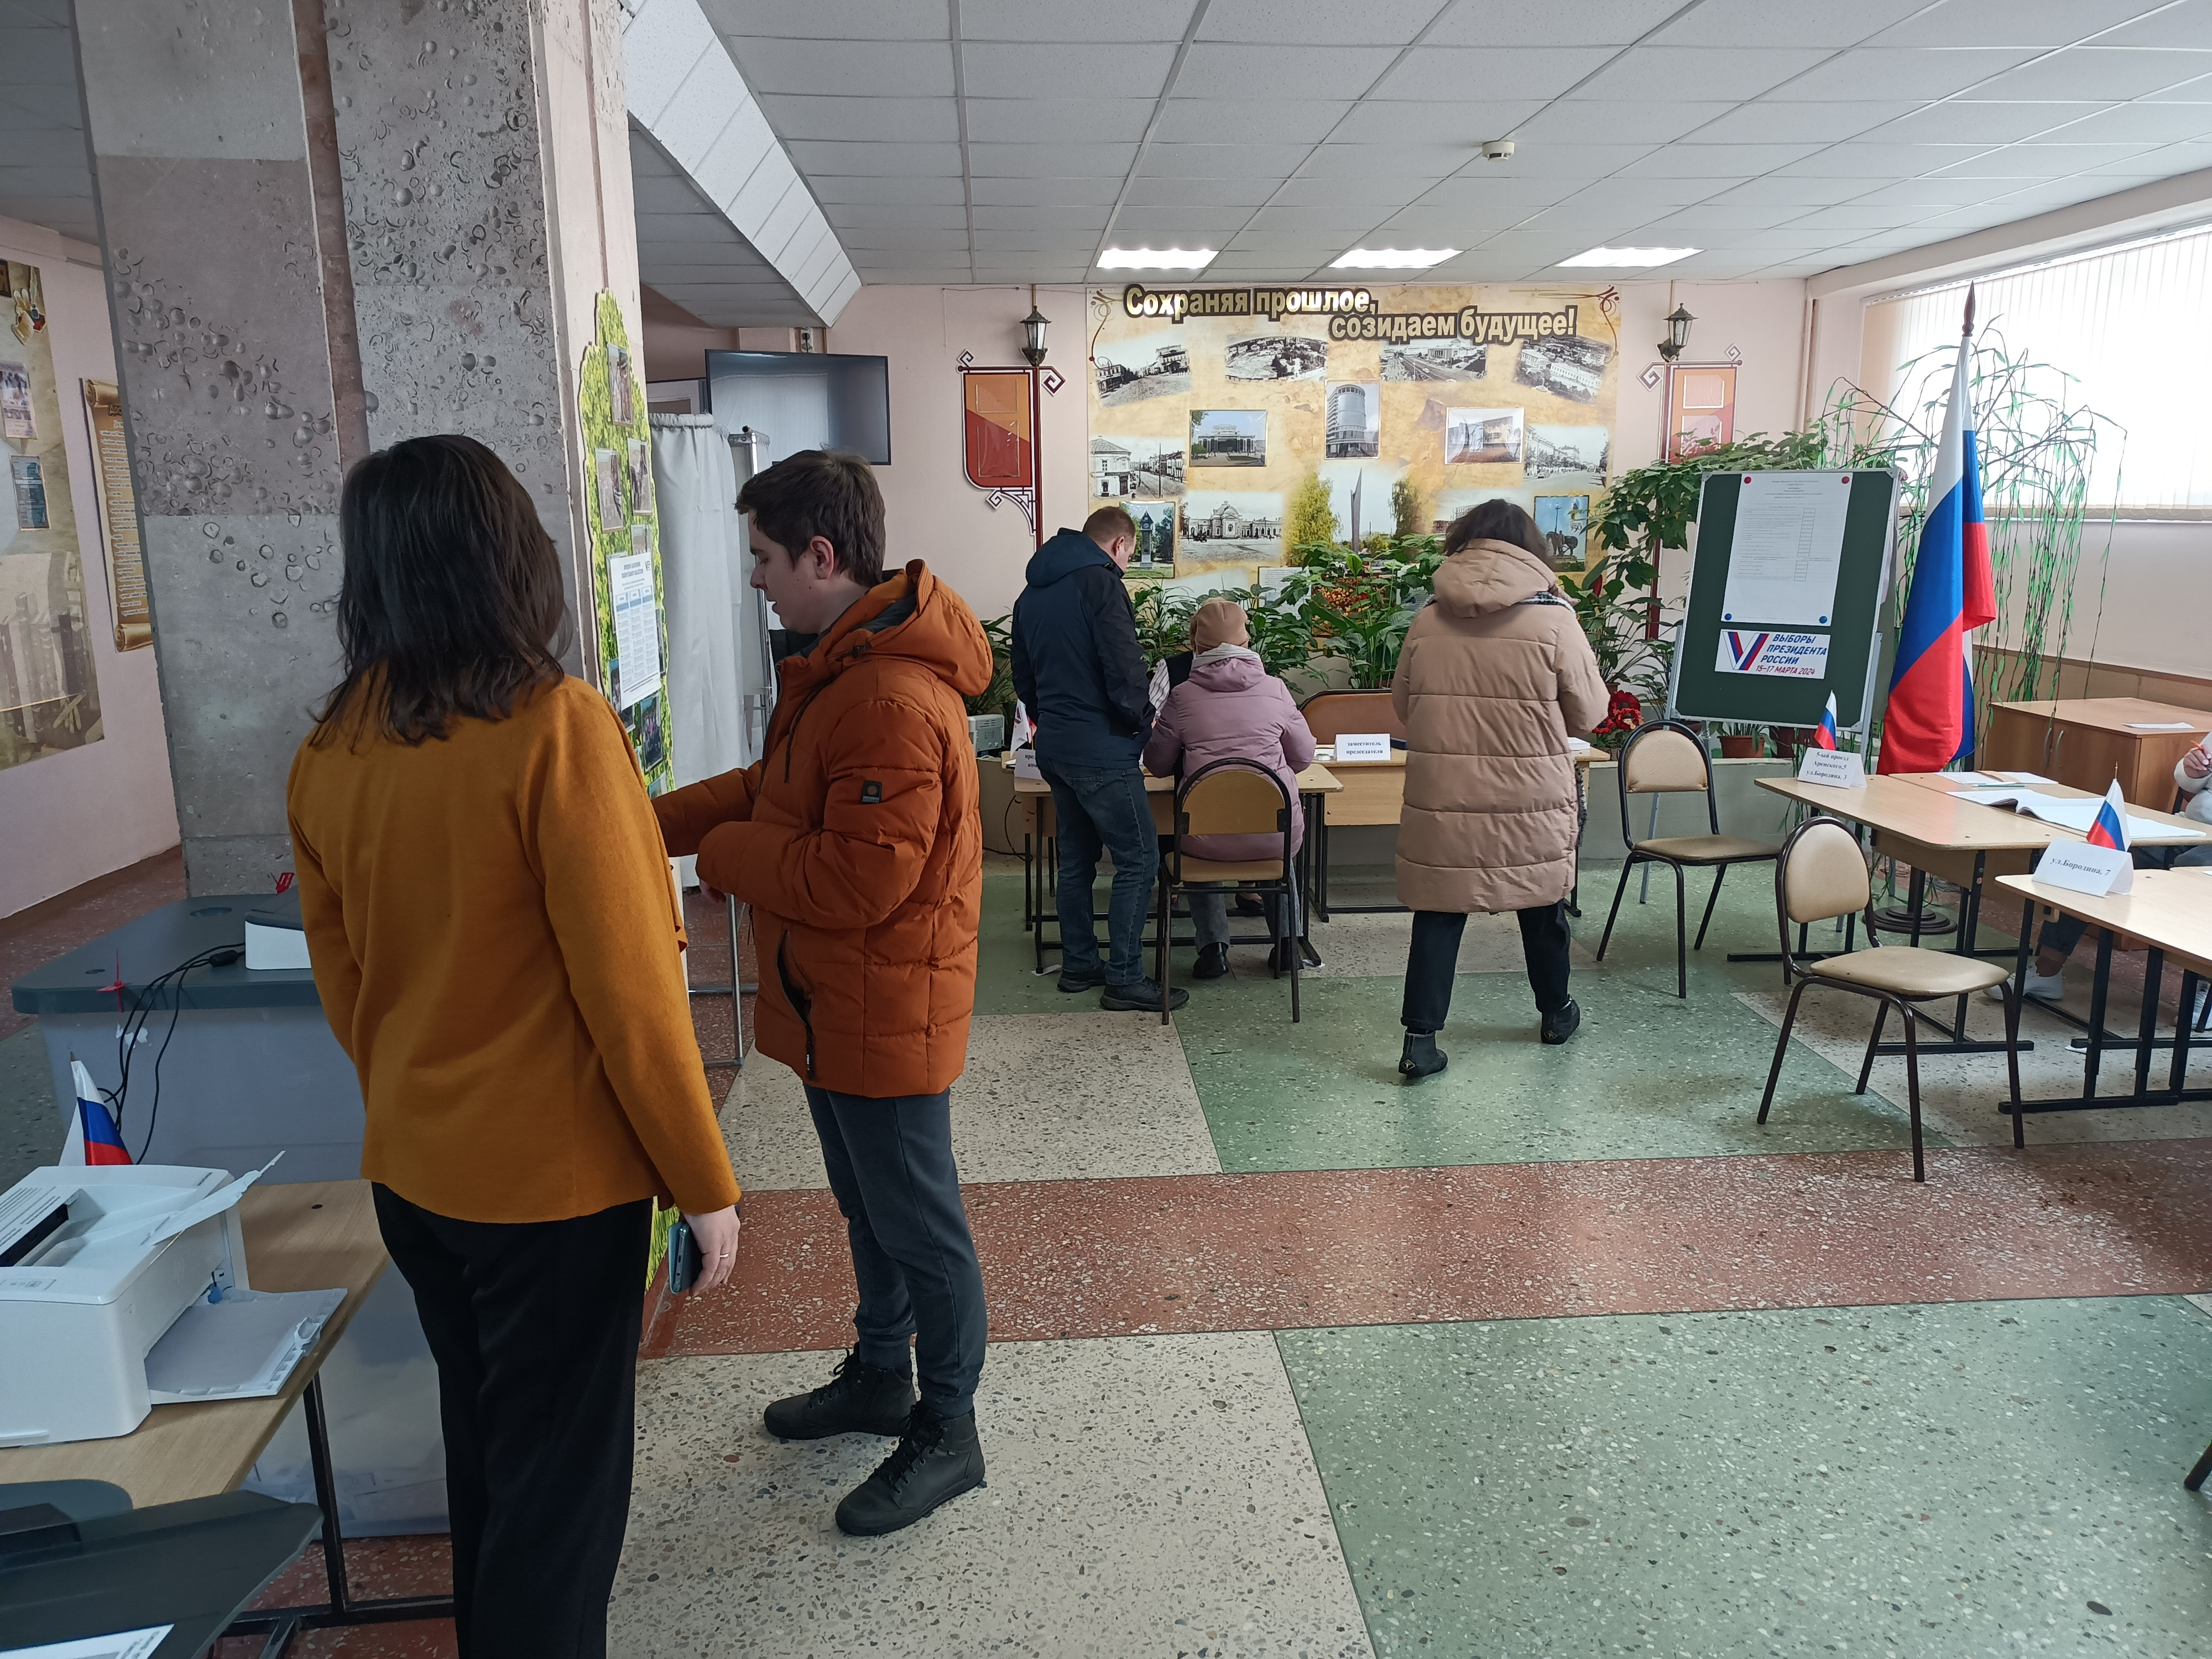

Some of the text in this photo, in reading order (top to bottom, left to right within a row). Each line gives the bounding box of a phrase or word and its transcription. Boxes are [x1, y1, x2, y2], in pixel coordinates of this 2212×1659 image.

[1126, 286, 1376, 321] Сохраняя прошлое,
[1332, 307, 1575, 343] созидаем будущее!
[1772, 634, 1816, 644] ВЫБОРЫ
[1766, 644, 1827, 655] ПРЕЗИДЕНТА
[1760, 655, 1799, 665] РОССИИ
[1774, 666, 1797, 674] МАРТА
